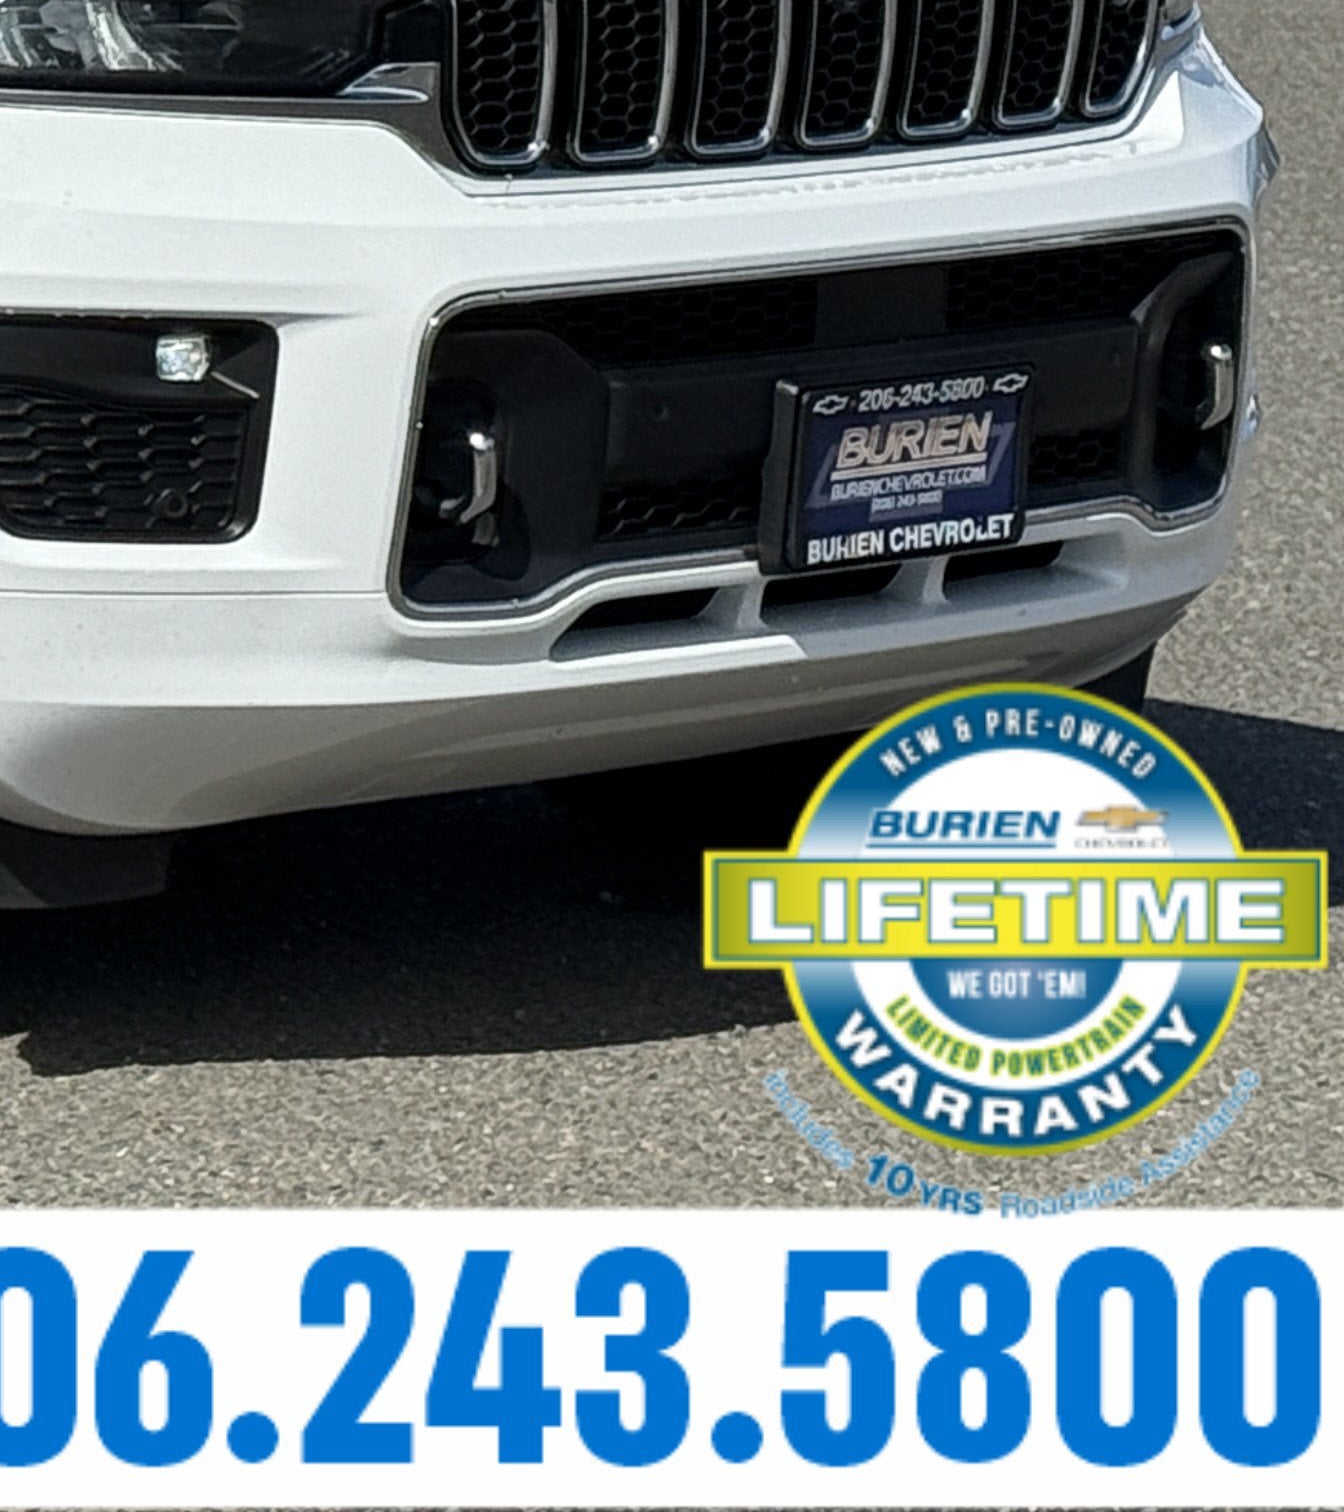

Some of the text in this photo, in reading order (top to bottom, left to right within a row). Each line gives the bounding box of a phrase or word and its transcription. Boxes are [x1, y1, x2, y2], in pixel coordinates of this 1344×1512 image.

[858, 376, 986, 412] 206-243-5800
[836, 410, 994, 469] BURIEN
[889, 513, 1015, 553] CHEVROLET
